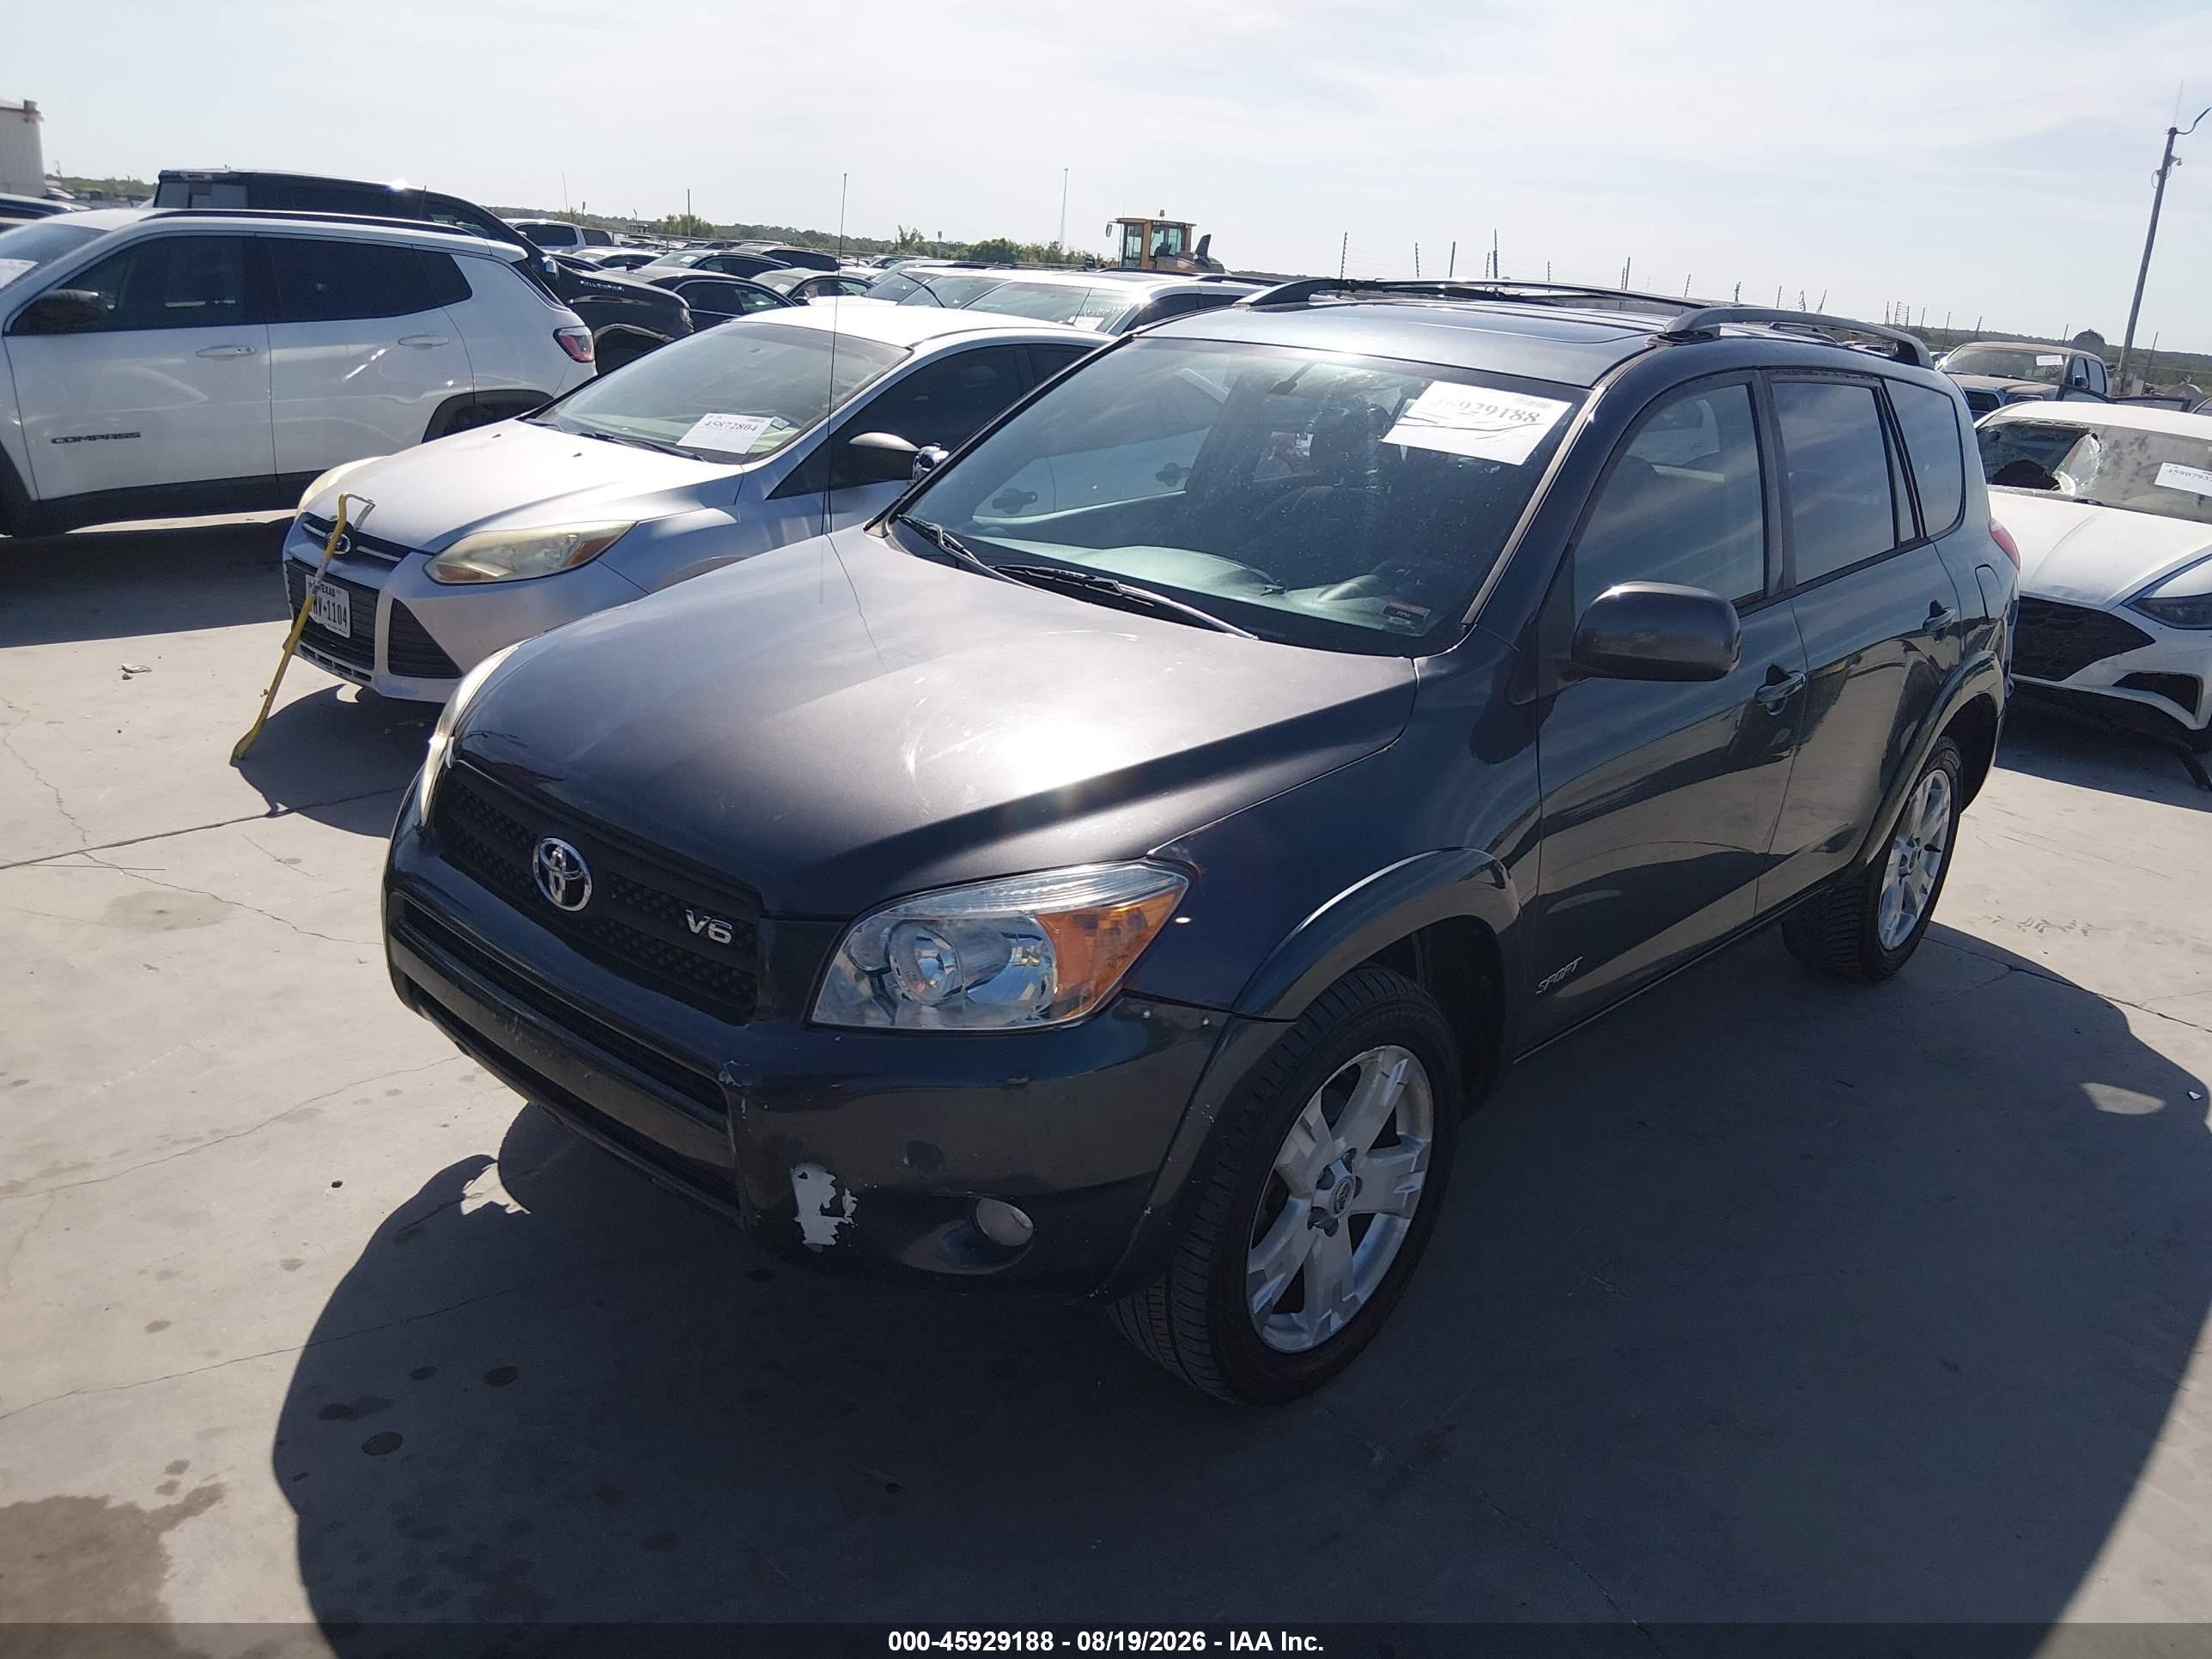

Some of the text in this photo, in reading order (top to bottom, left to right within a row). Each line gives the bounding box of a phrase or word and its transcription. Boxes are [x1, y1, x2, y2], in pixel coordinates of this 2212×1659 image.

[703, 419, 759, 432] 45872804
[51, 432, 142, 445] COMPASS
[684, 908, 734, 944] V6
[1534, 956, 1584, 995] SPORT
